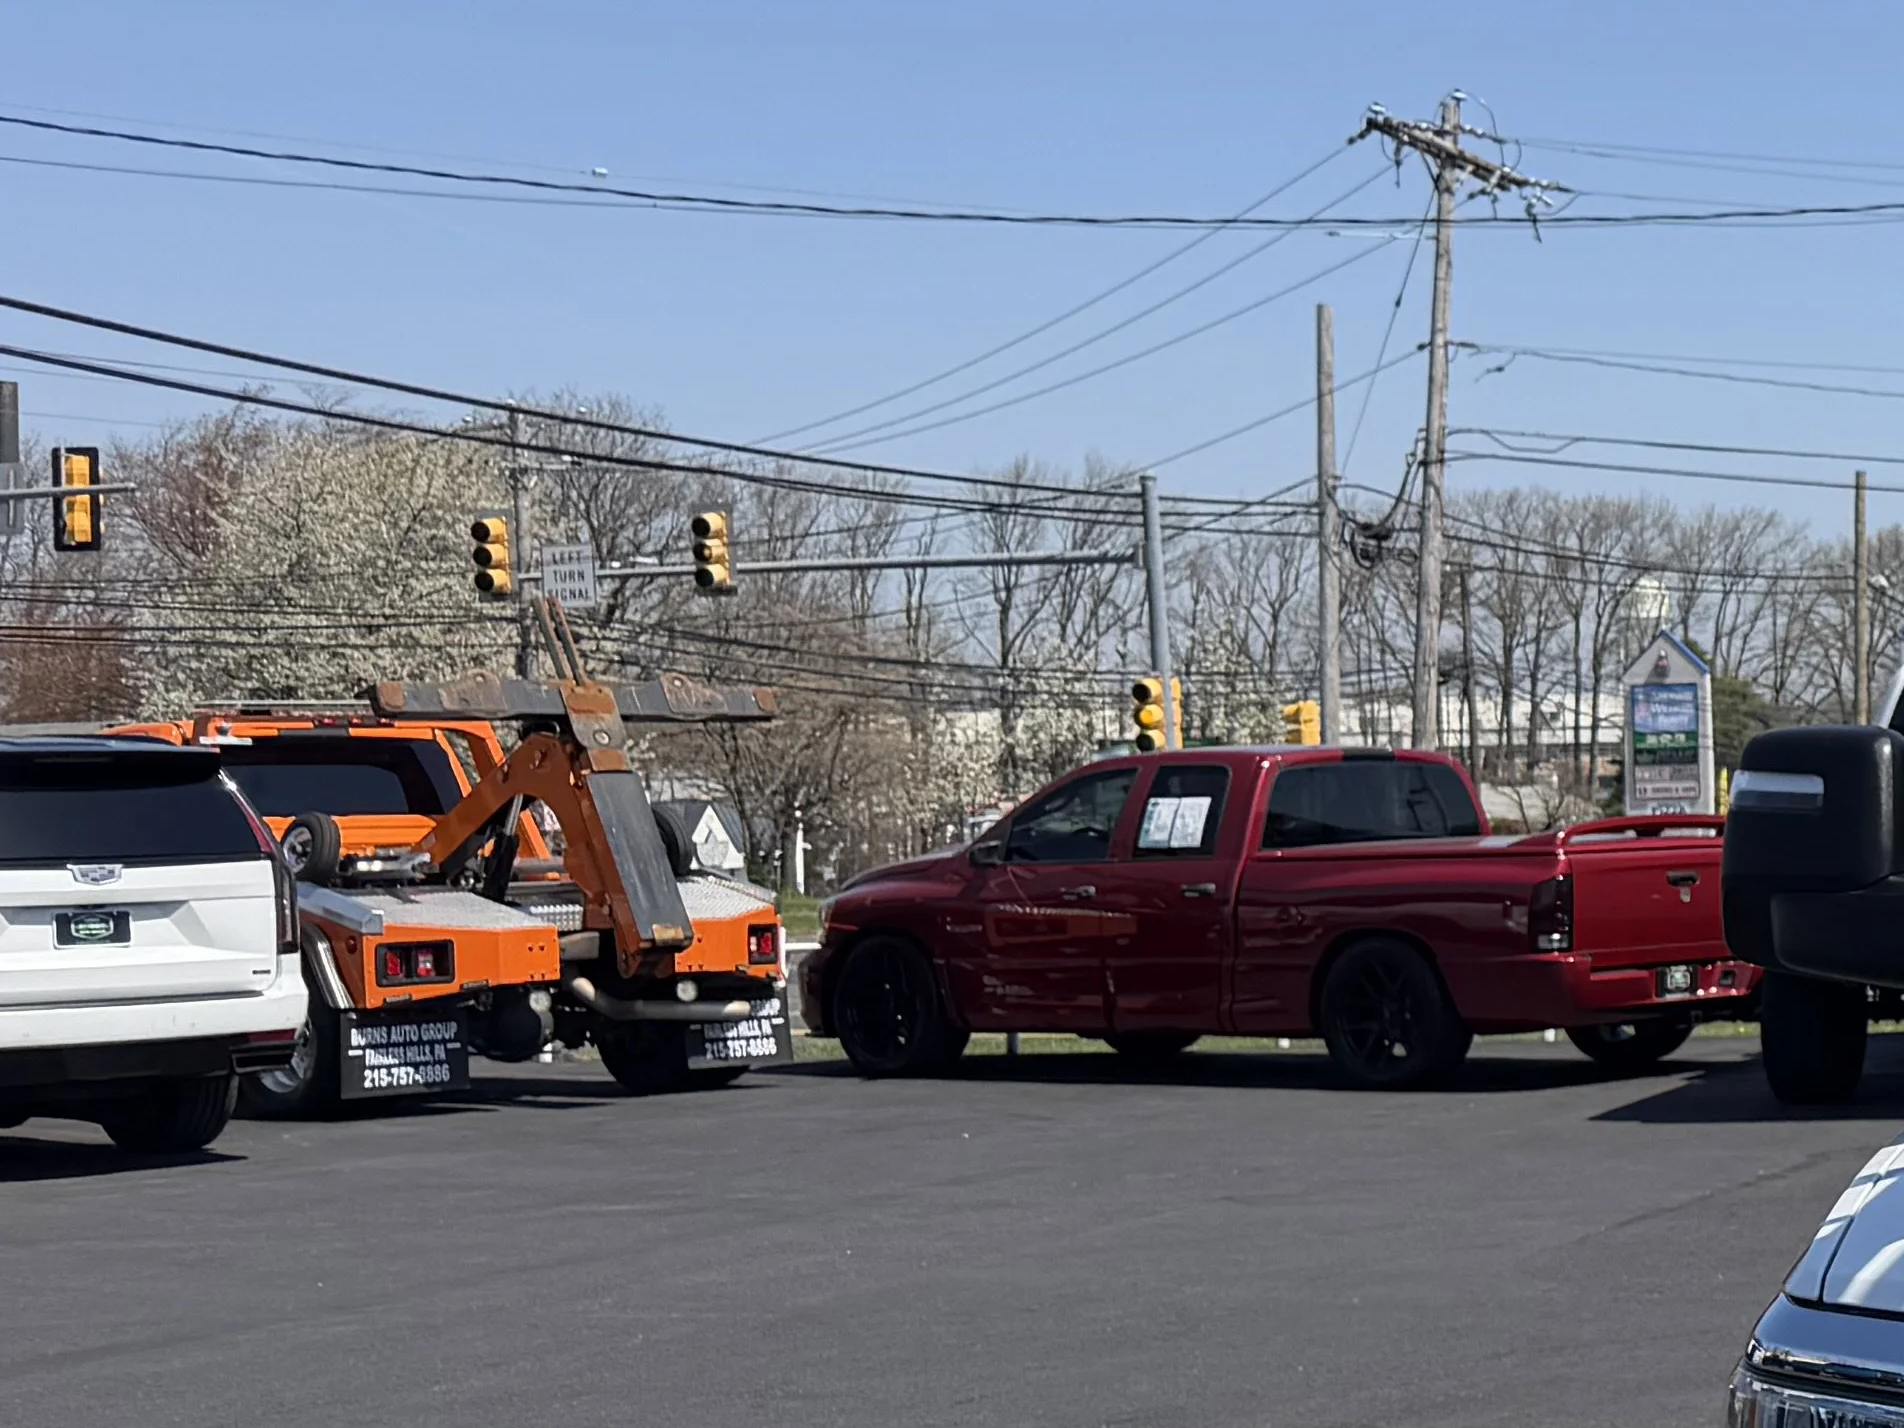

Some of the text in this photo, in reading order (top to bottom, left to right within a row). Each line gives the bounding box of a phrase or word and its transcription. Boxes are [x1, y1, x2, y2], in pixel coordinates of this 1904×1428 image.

[551, 551, 584, 565] LEFT
[553, 569, 585, 583] TURN
[390, 1024, 419, 1044] AUTO
[420, 1021, 458, 1041] GROUP
[434, 1043, 446, 1061] PA
